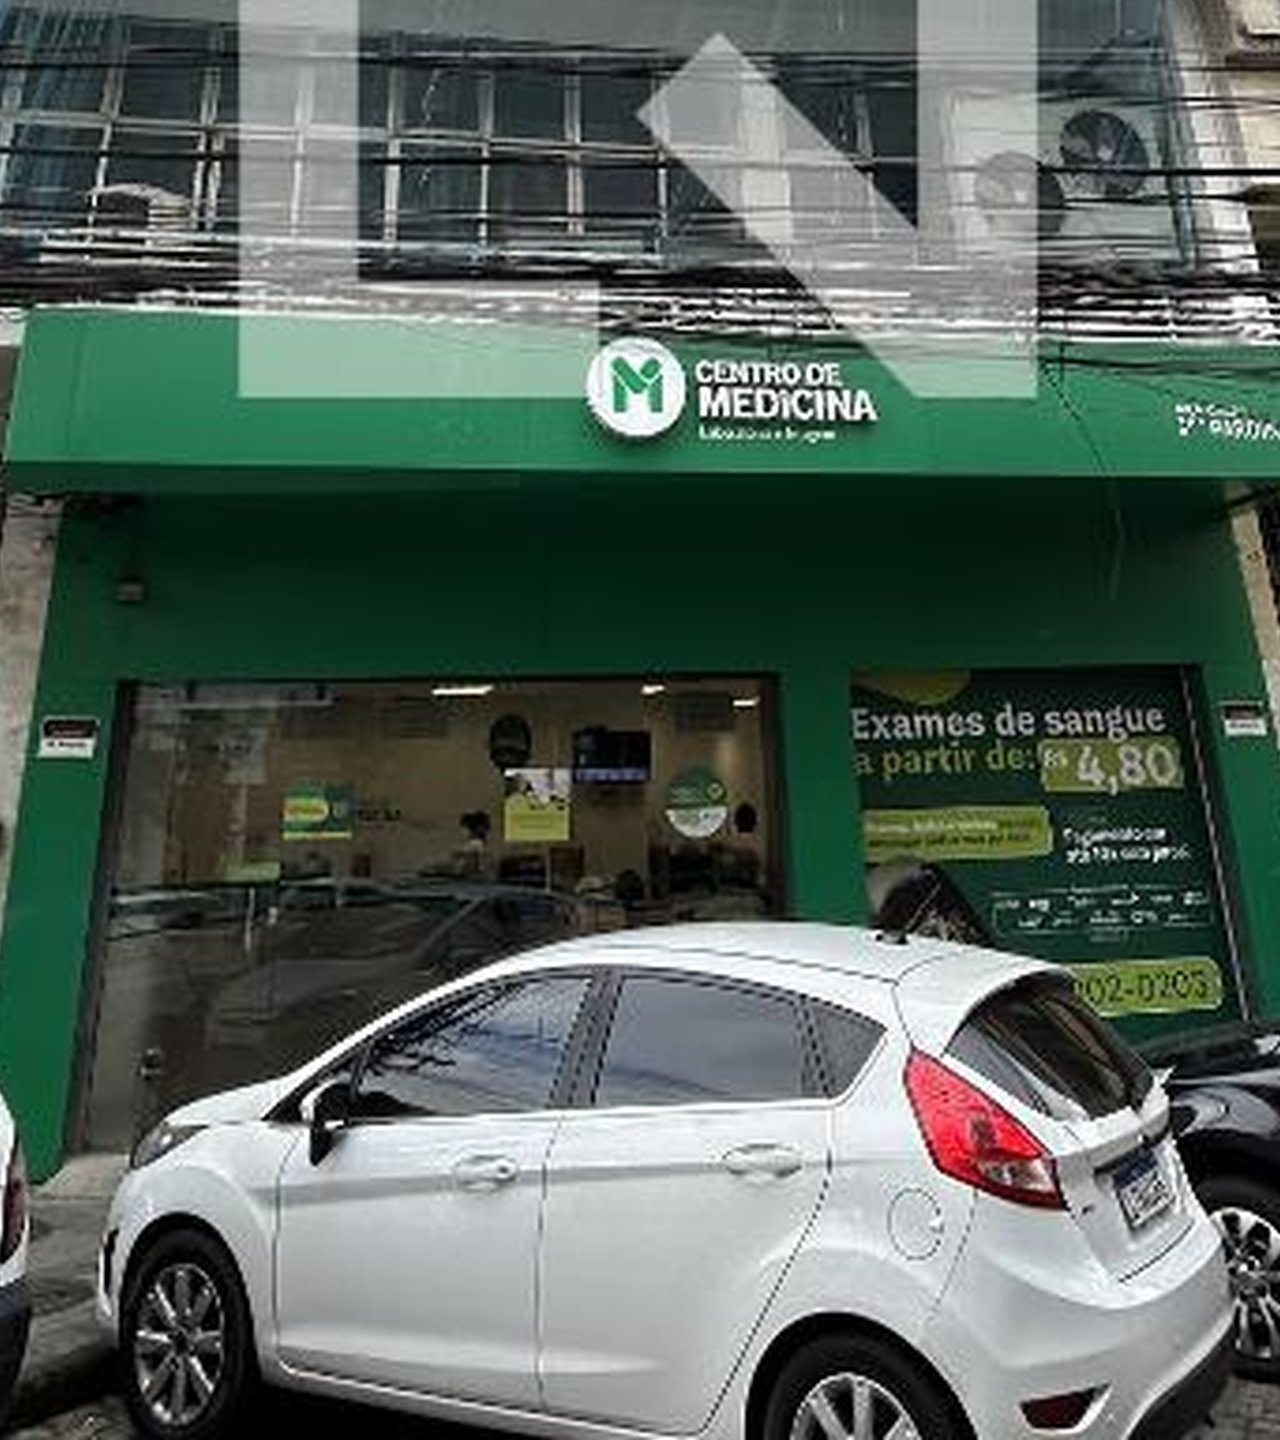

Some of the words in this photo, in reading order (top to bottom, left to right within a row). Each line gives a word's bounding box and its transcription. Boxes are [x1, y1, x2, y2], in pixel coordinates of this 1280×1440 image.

[695, 359, 801, 385] CENTRO
[806, 363, 843, 387] DE
[698, 386, 878, 421] MEDICINA
[851, 709, 986, 741] Exames
[995, 702, 1036, 737] de
[1044, 704, 1167, 743] sangue
[882, 741, 976, 781] partir
[986, 740, 1035, 771] de:
[1077, 743, 1178, 796] 4,80
